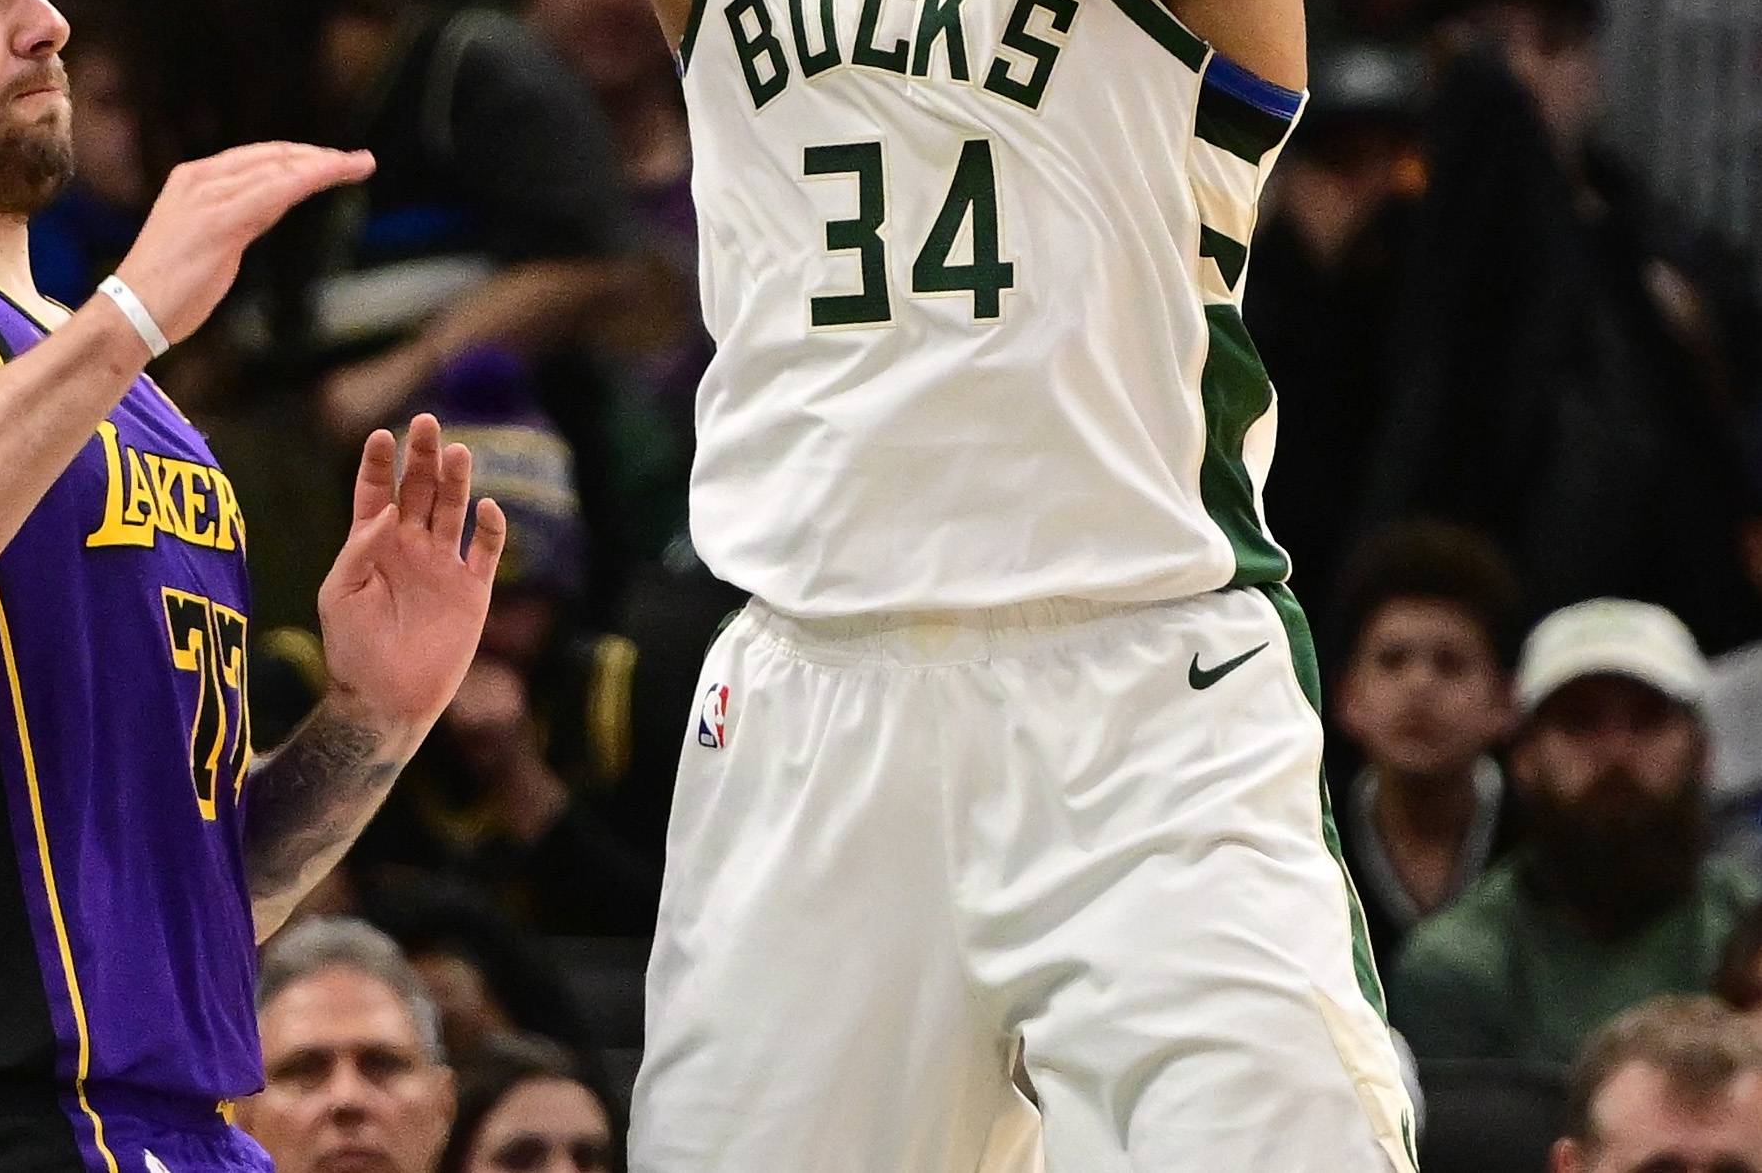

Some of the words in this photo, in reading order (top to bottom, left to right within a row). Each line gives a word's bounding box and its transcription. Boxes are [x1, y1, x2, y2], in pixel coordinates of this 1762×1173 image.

[801, 136, 1017, 330] 34
[85, 419, 247, 561] LAKER
[160, 585, 252, 823] 77
